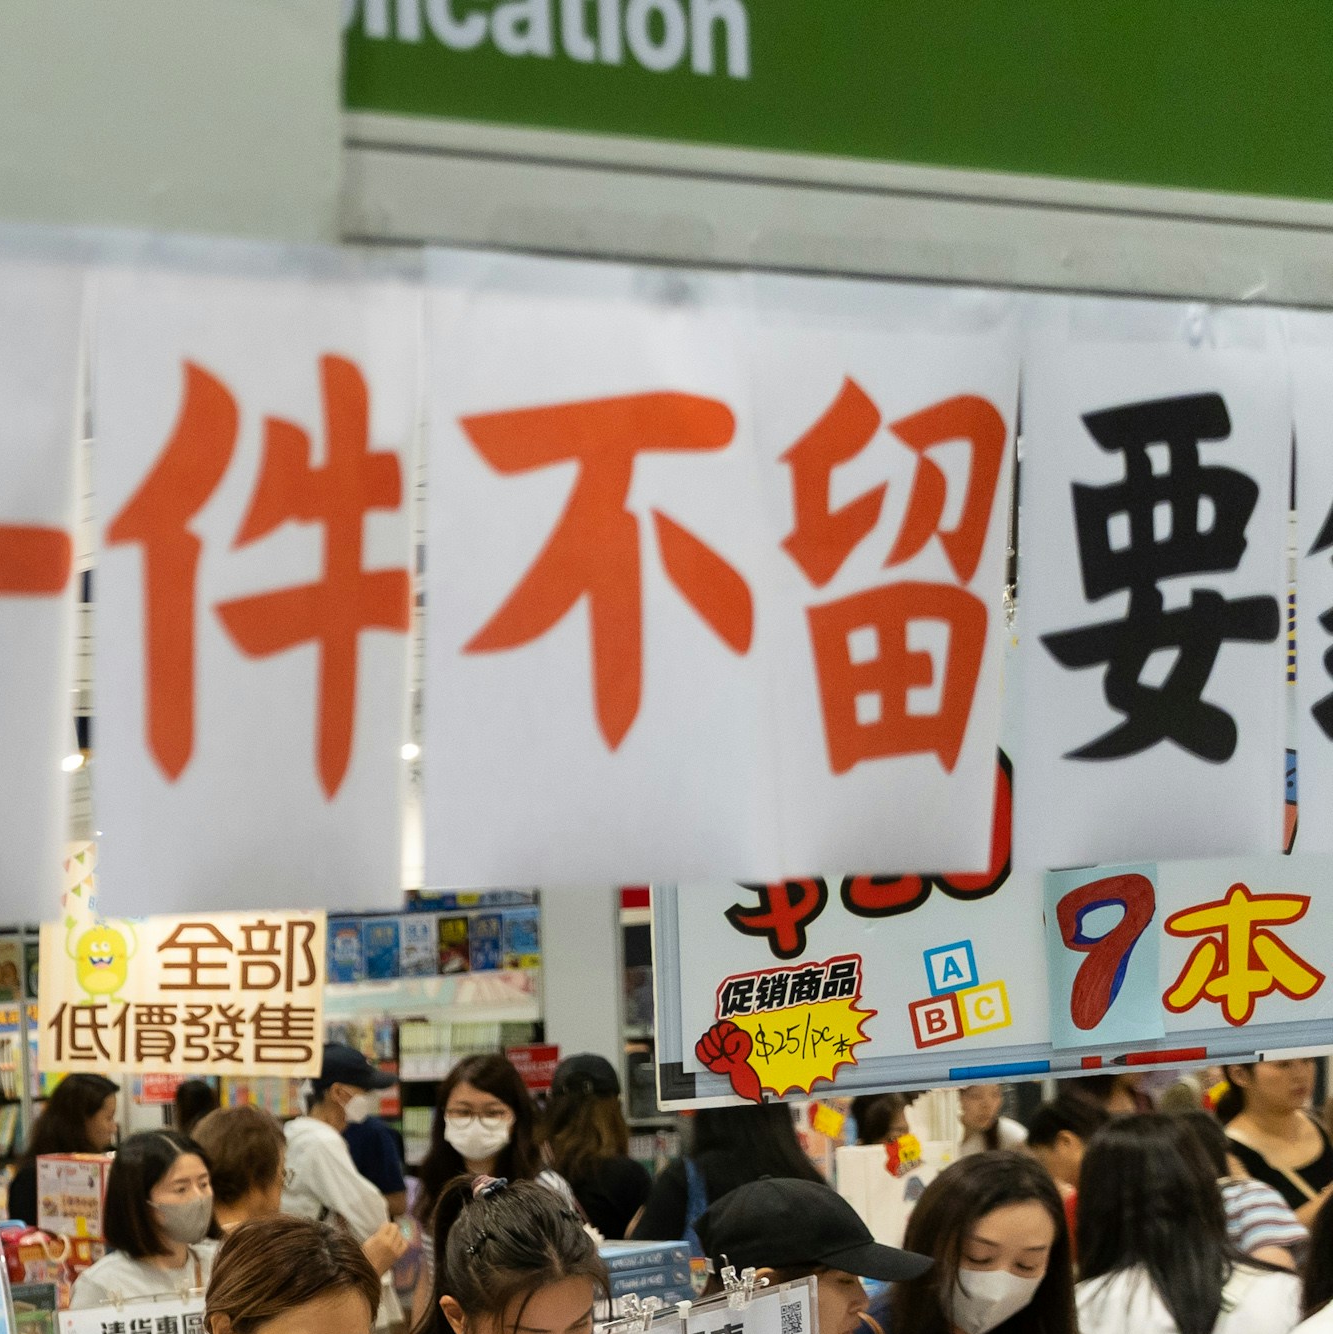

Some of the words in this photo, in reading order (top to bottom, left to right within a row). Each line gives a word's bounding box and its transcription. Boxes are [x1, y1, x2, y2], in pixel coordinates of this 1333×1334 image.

[336, 0, 751, 80] cation
[1038, 392, 1333, 766] 要
[158, 920, 316, 992] 全部
[942, 956, 960, 981] A
[1057, 873, 1325, 1030] 9本
[720, 959, 859, 1018] 促销商品
[925, 1009, 948, 1033] B
[972, 996, 995, 1019] C
[48, 1002, 320, 1064] 低價發售
